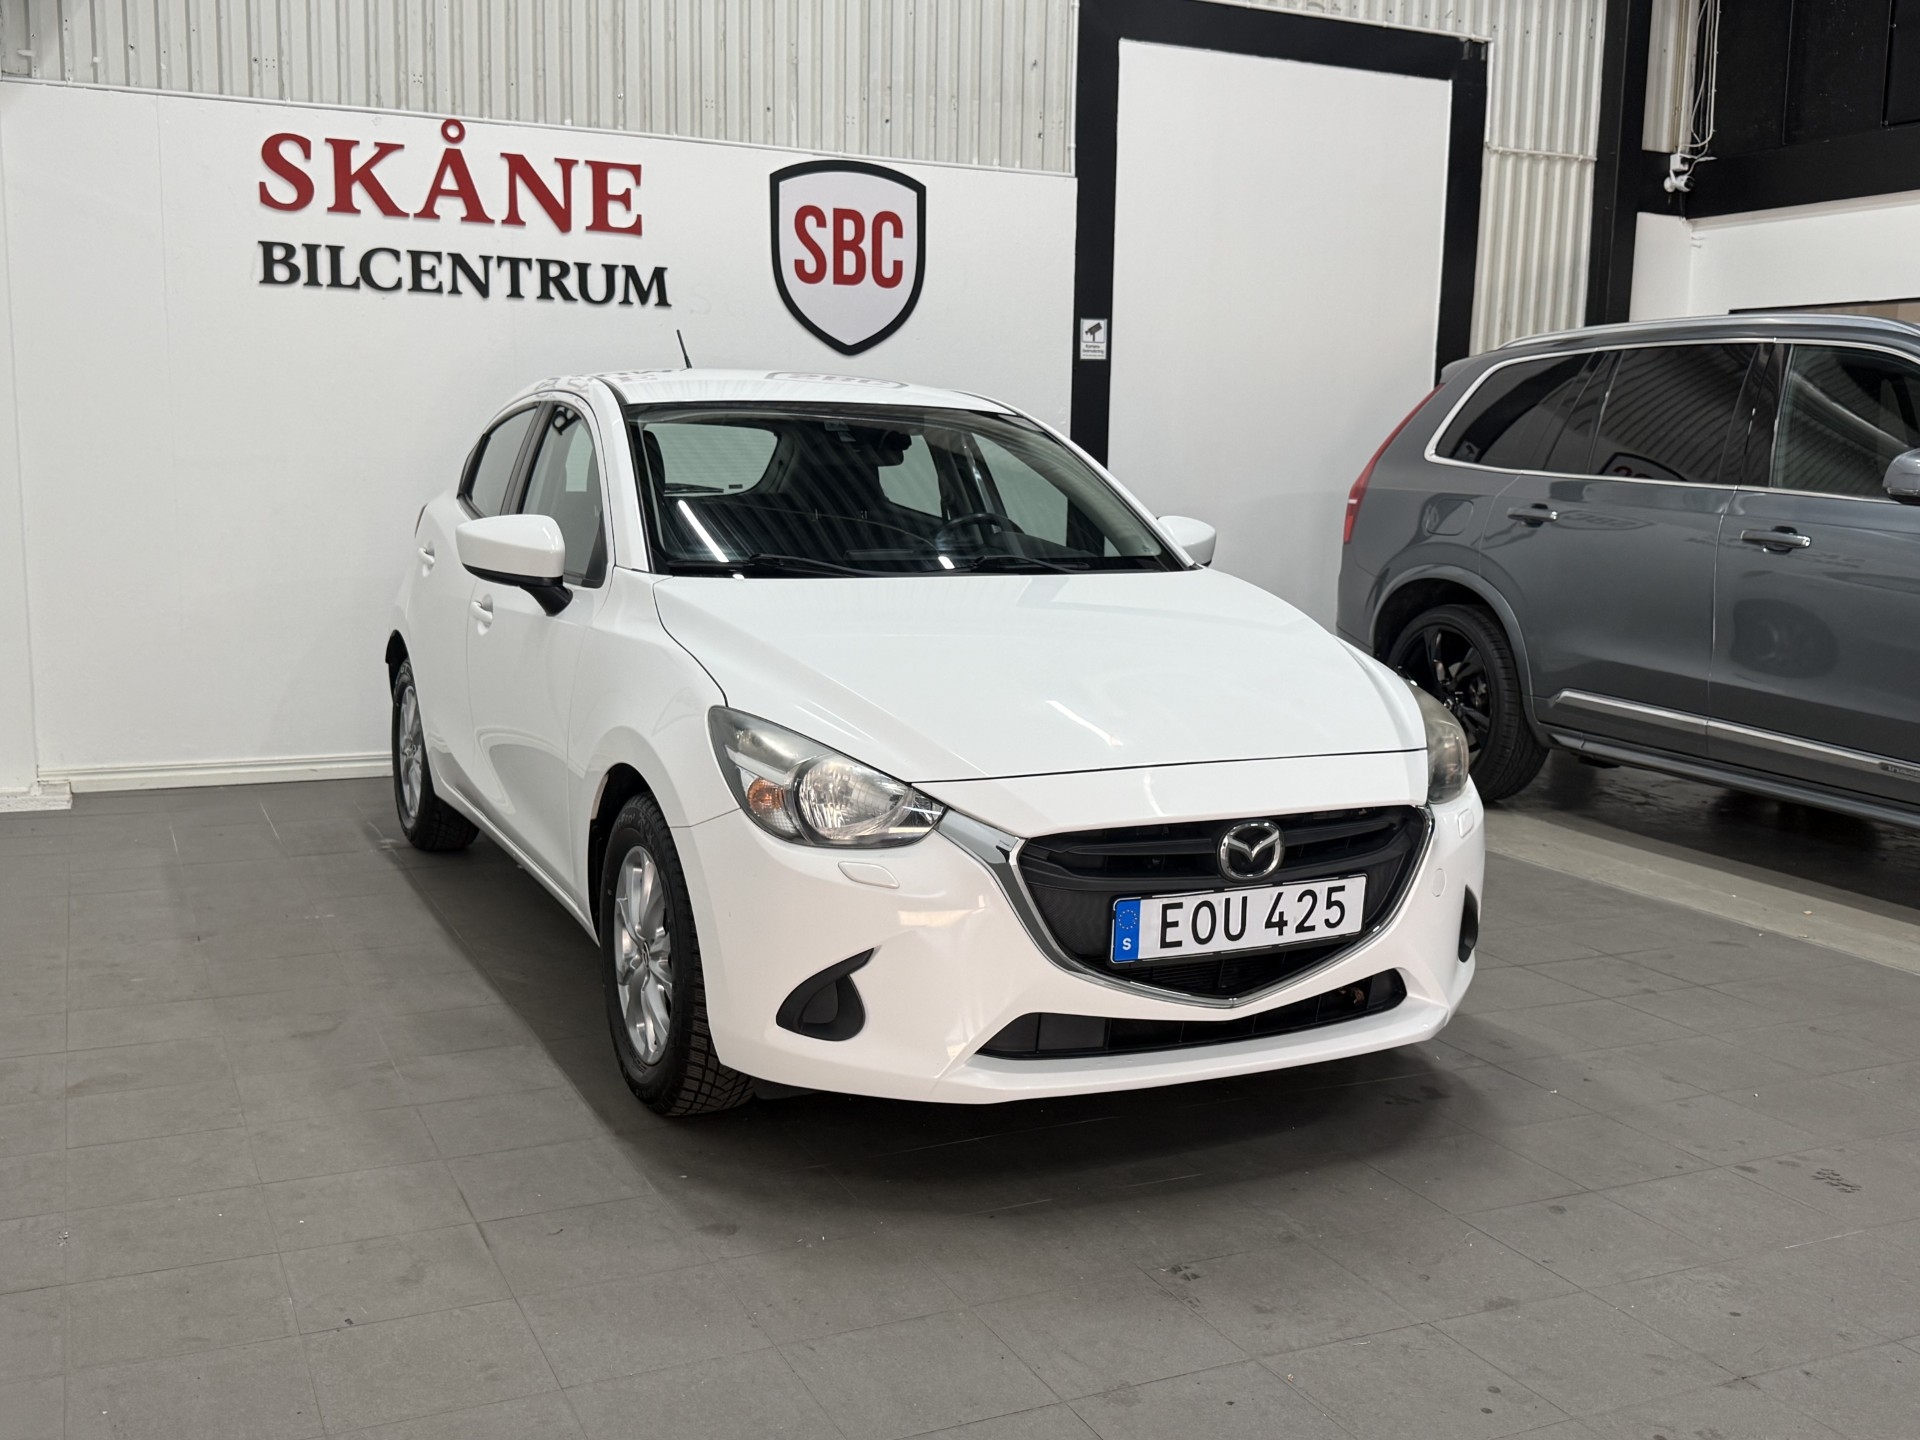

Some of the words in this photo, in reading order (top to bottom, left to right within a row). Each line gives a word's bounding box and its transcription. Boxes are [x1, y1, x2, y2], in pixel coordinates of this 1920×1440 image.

[259, 119, 643, 236] SKÅNE
[258, 241, 672, 307] BILCENTRUM
[794, 205, 904, 289] SBC
[1122, 937, 1132, 951] S
[1159, 896, 1248, 949] EOU
[1264, 885, 1346, 936] 425
